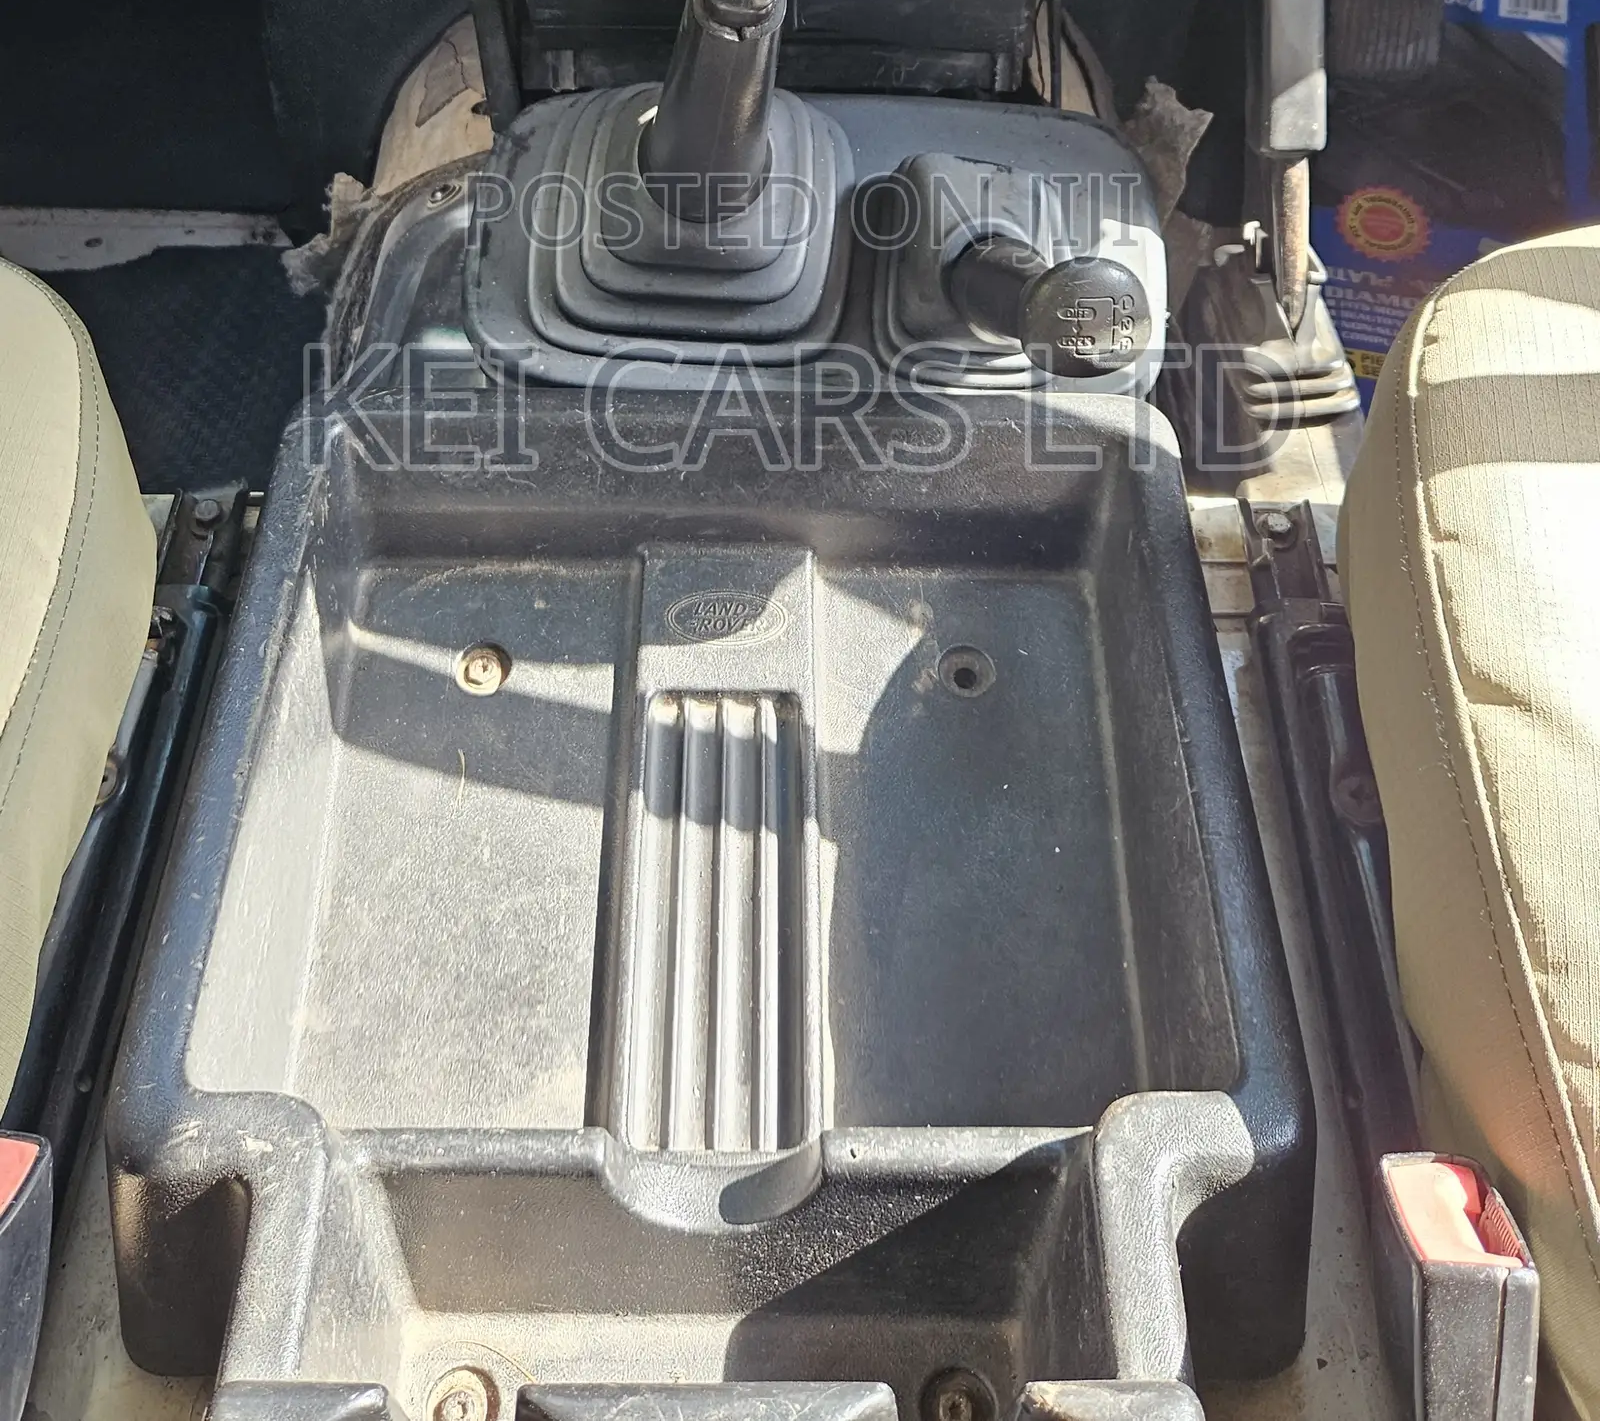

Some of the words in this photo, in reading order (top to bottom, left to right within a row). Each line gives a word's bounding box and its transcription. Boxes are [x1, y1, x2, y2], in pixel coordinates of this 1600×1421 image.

[1324, 285, 1419, 309] DIAMO
[1065, 309, 1090, 319] DIFF
[694, 600, 749, 617] LAND
[695, 617, 766, 633] ROVER
